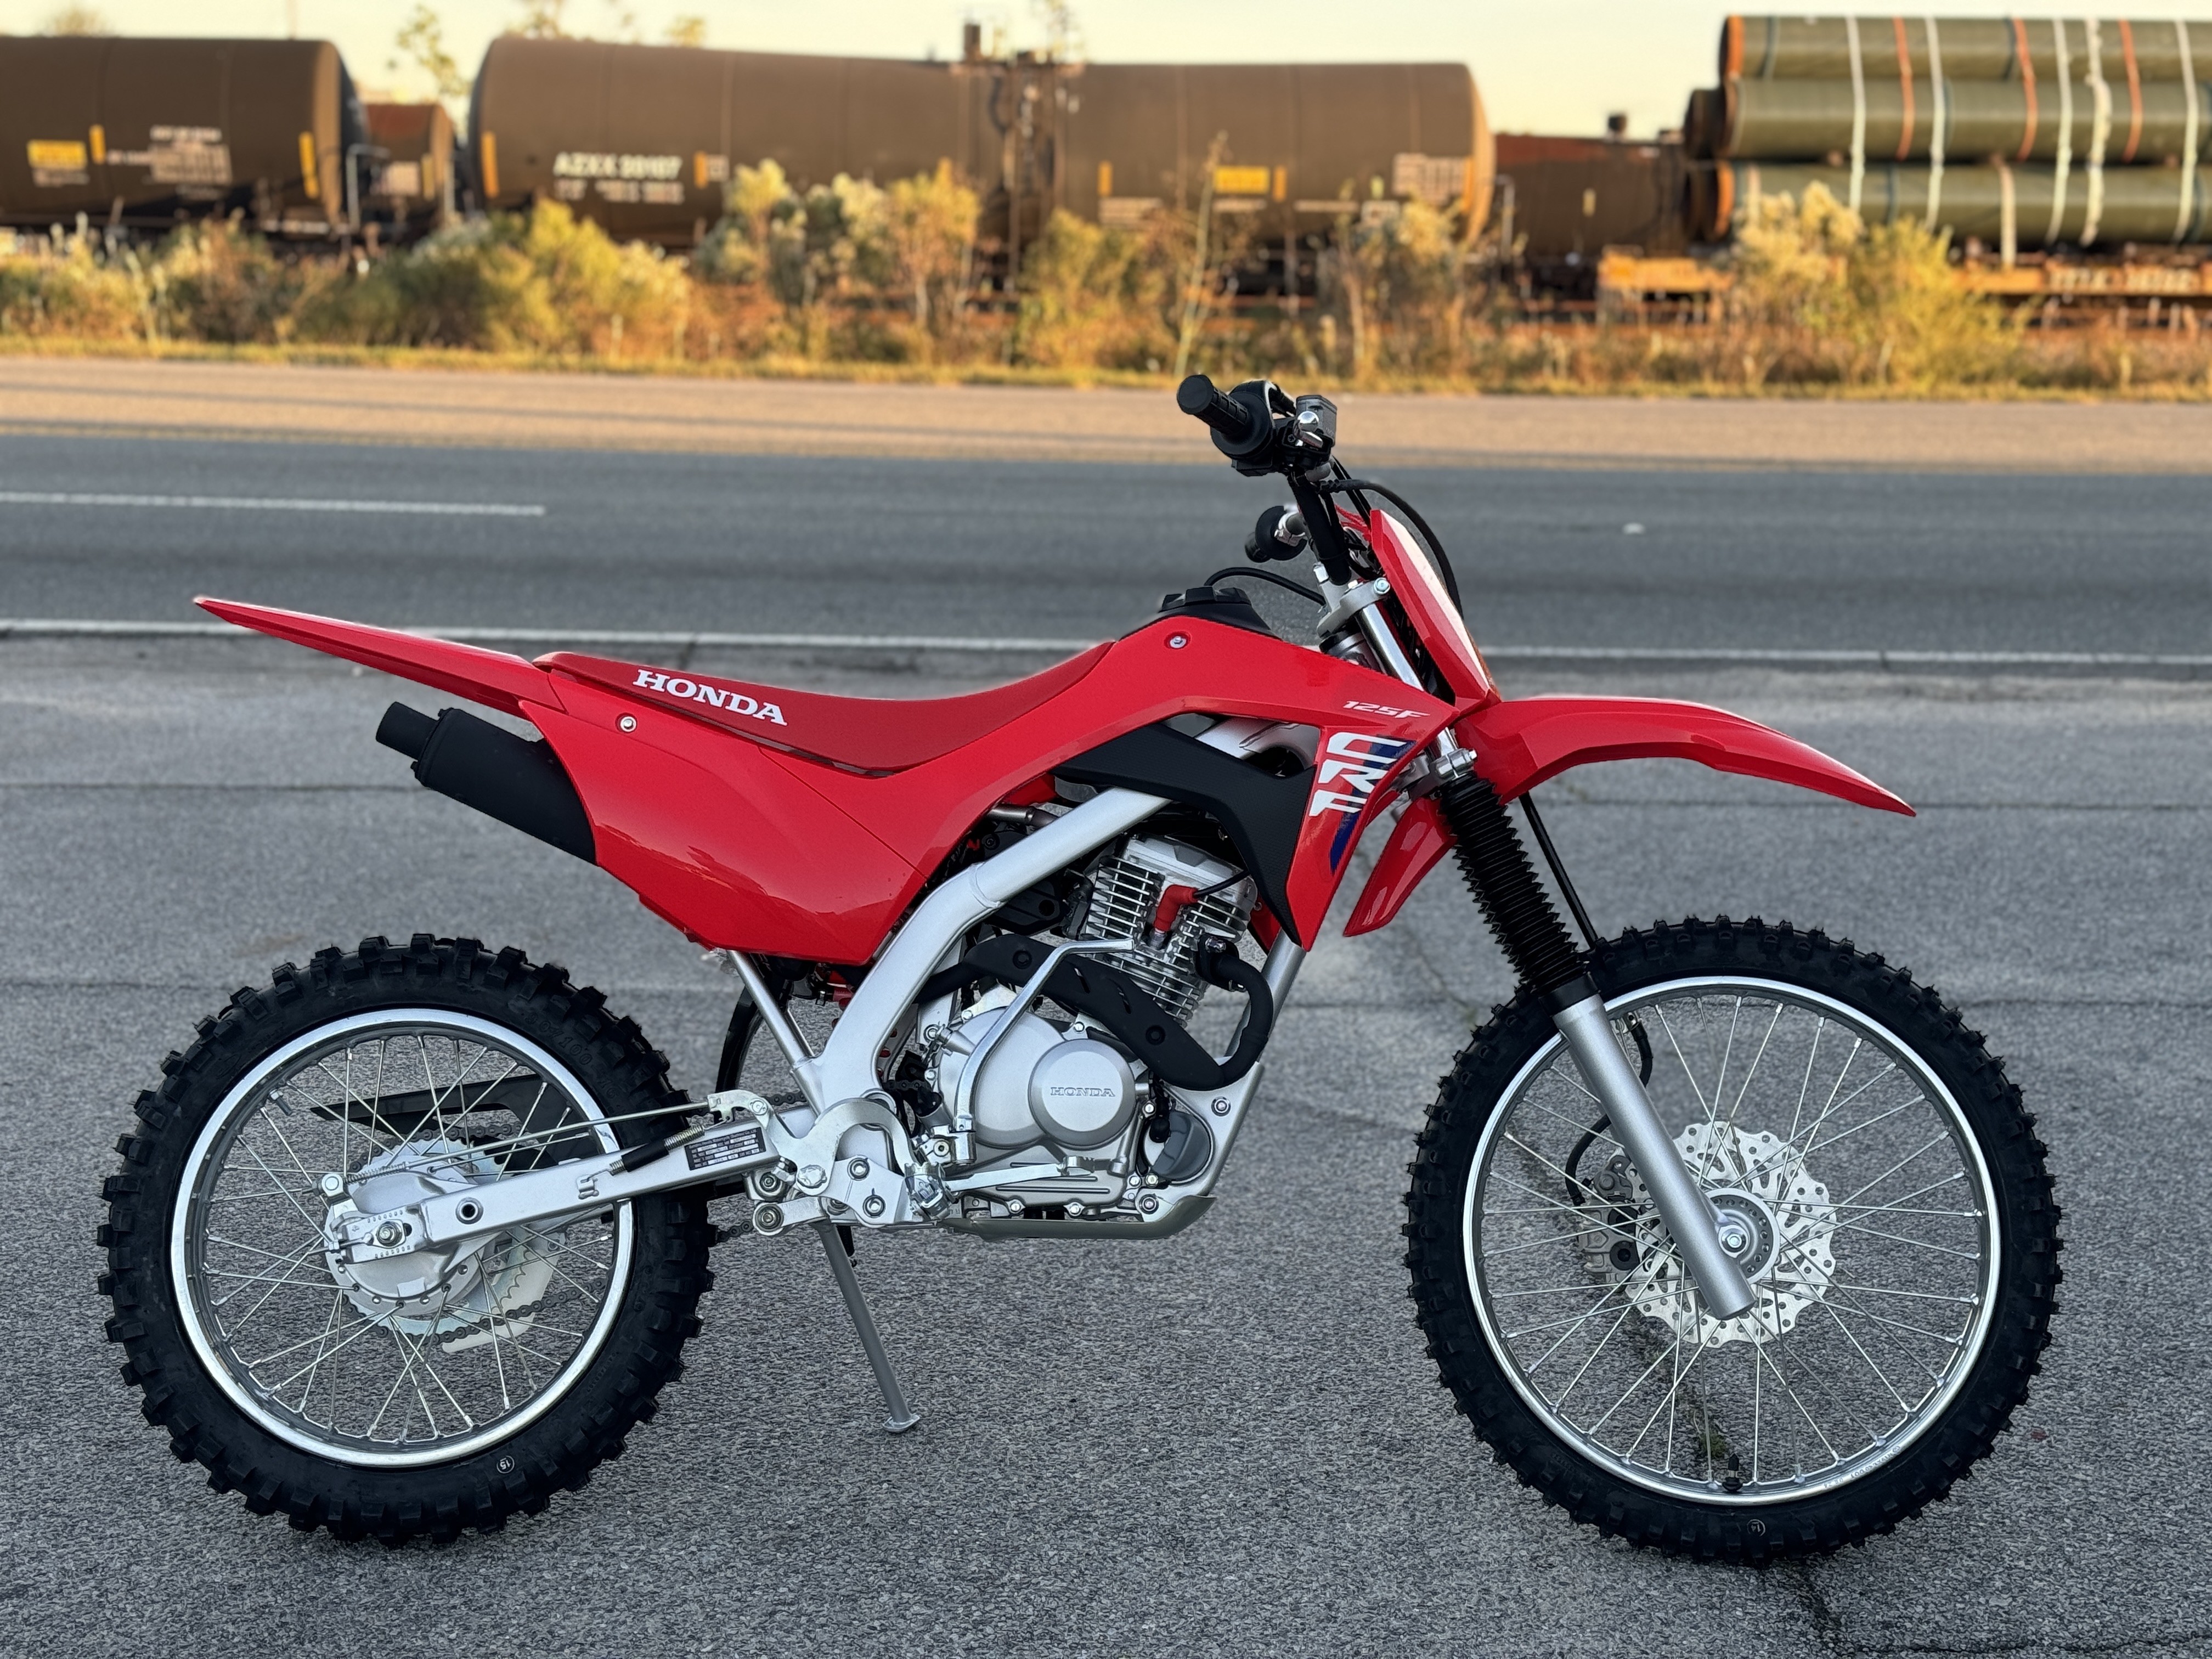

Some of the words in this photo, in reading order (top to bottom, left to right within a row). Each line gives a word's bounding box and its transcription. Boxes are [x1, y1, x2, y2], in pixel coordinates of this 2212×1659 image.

[633, 669, 788, 726] HONDA
[1343, 701, 1431, 719] 125F
[1308, 732, 1407, 817] CRF
[1050, 1087, 1116, 1097] HONDA
